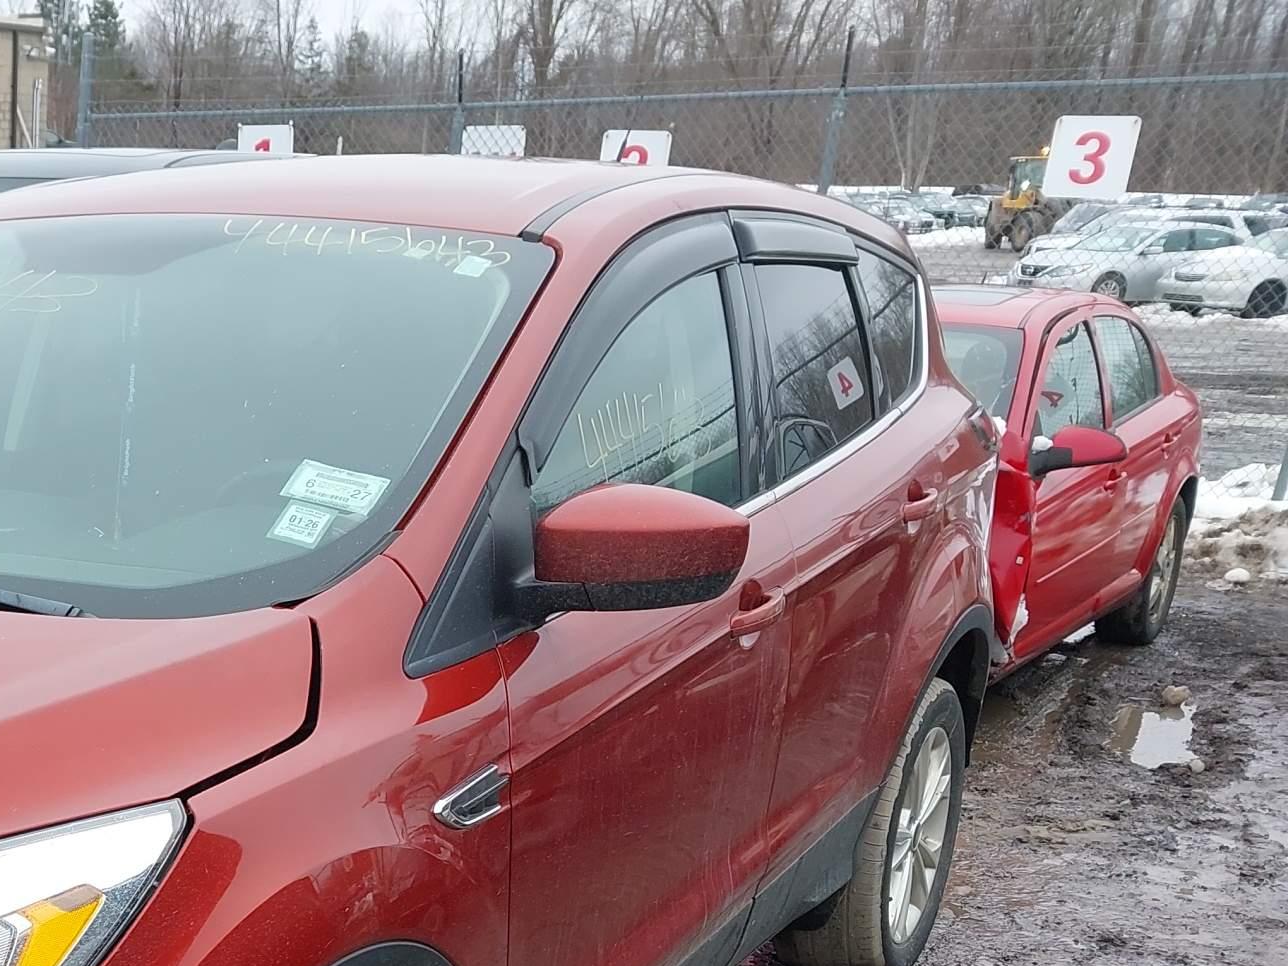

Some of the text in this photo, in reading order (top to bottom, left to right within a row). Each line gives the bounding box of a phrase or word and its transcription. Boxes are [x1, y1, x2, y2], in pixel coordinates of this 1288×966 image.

[1068, 131, 1111, 185] 3
[305, 478, 317, 488] 6
[350, 489, 373, 501] 27
